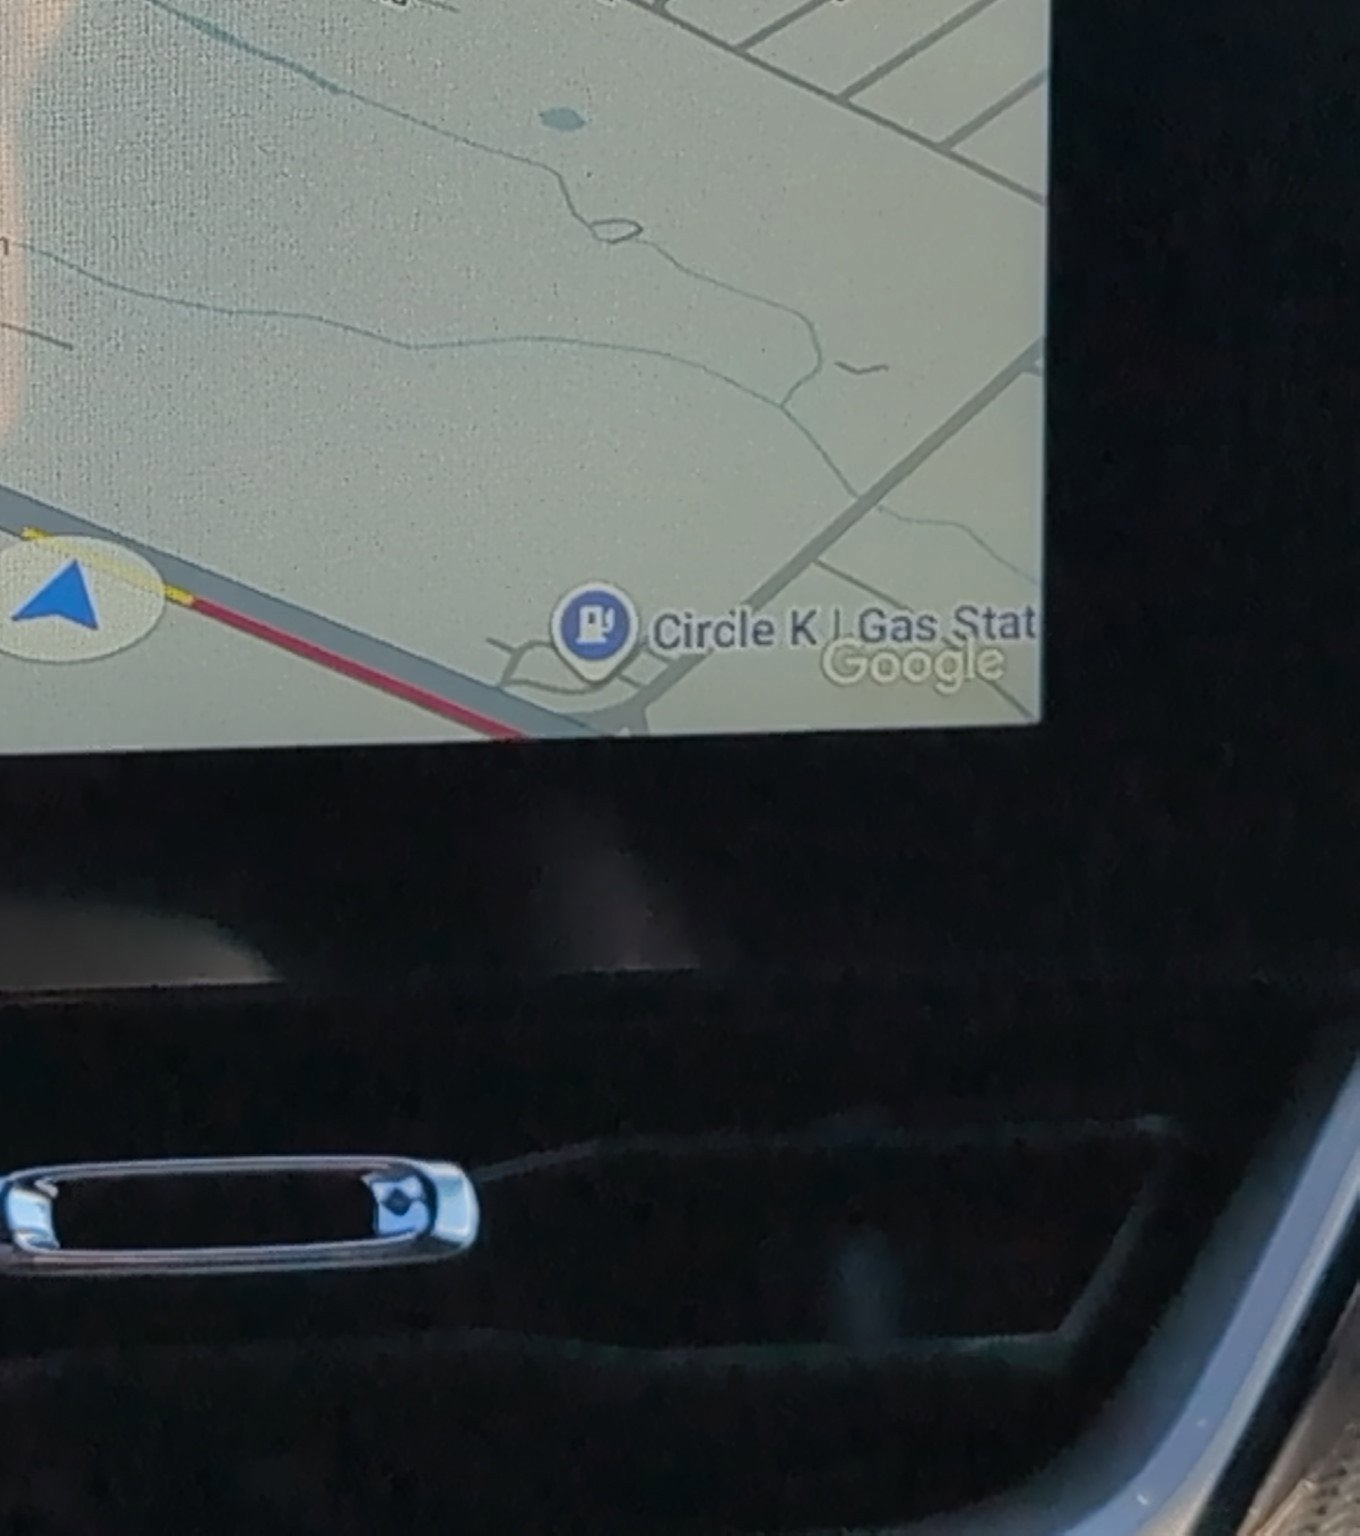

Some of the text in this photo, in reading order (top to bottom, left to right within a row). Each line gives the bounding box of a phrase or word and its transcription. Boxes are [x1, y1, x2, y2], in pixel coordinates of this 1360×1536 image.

[653, 613, 777, 651] Circle
[789, 610, 817, 646] K
[859, 607, 938, 645] Gas
[958, 605, 1039, 643] Stat
[821, 645, 1007, 696] Google
